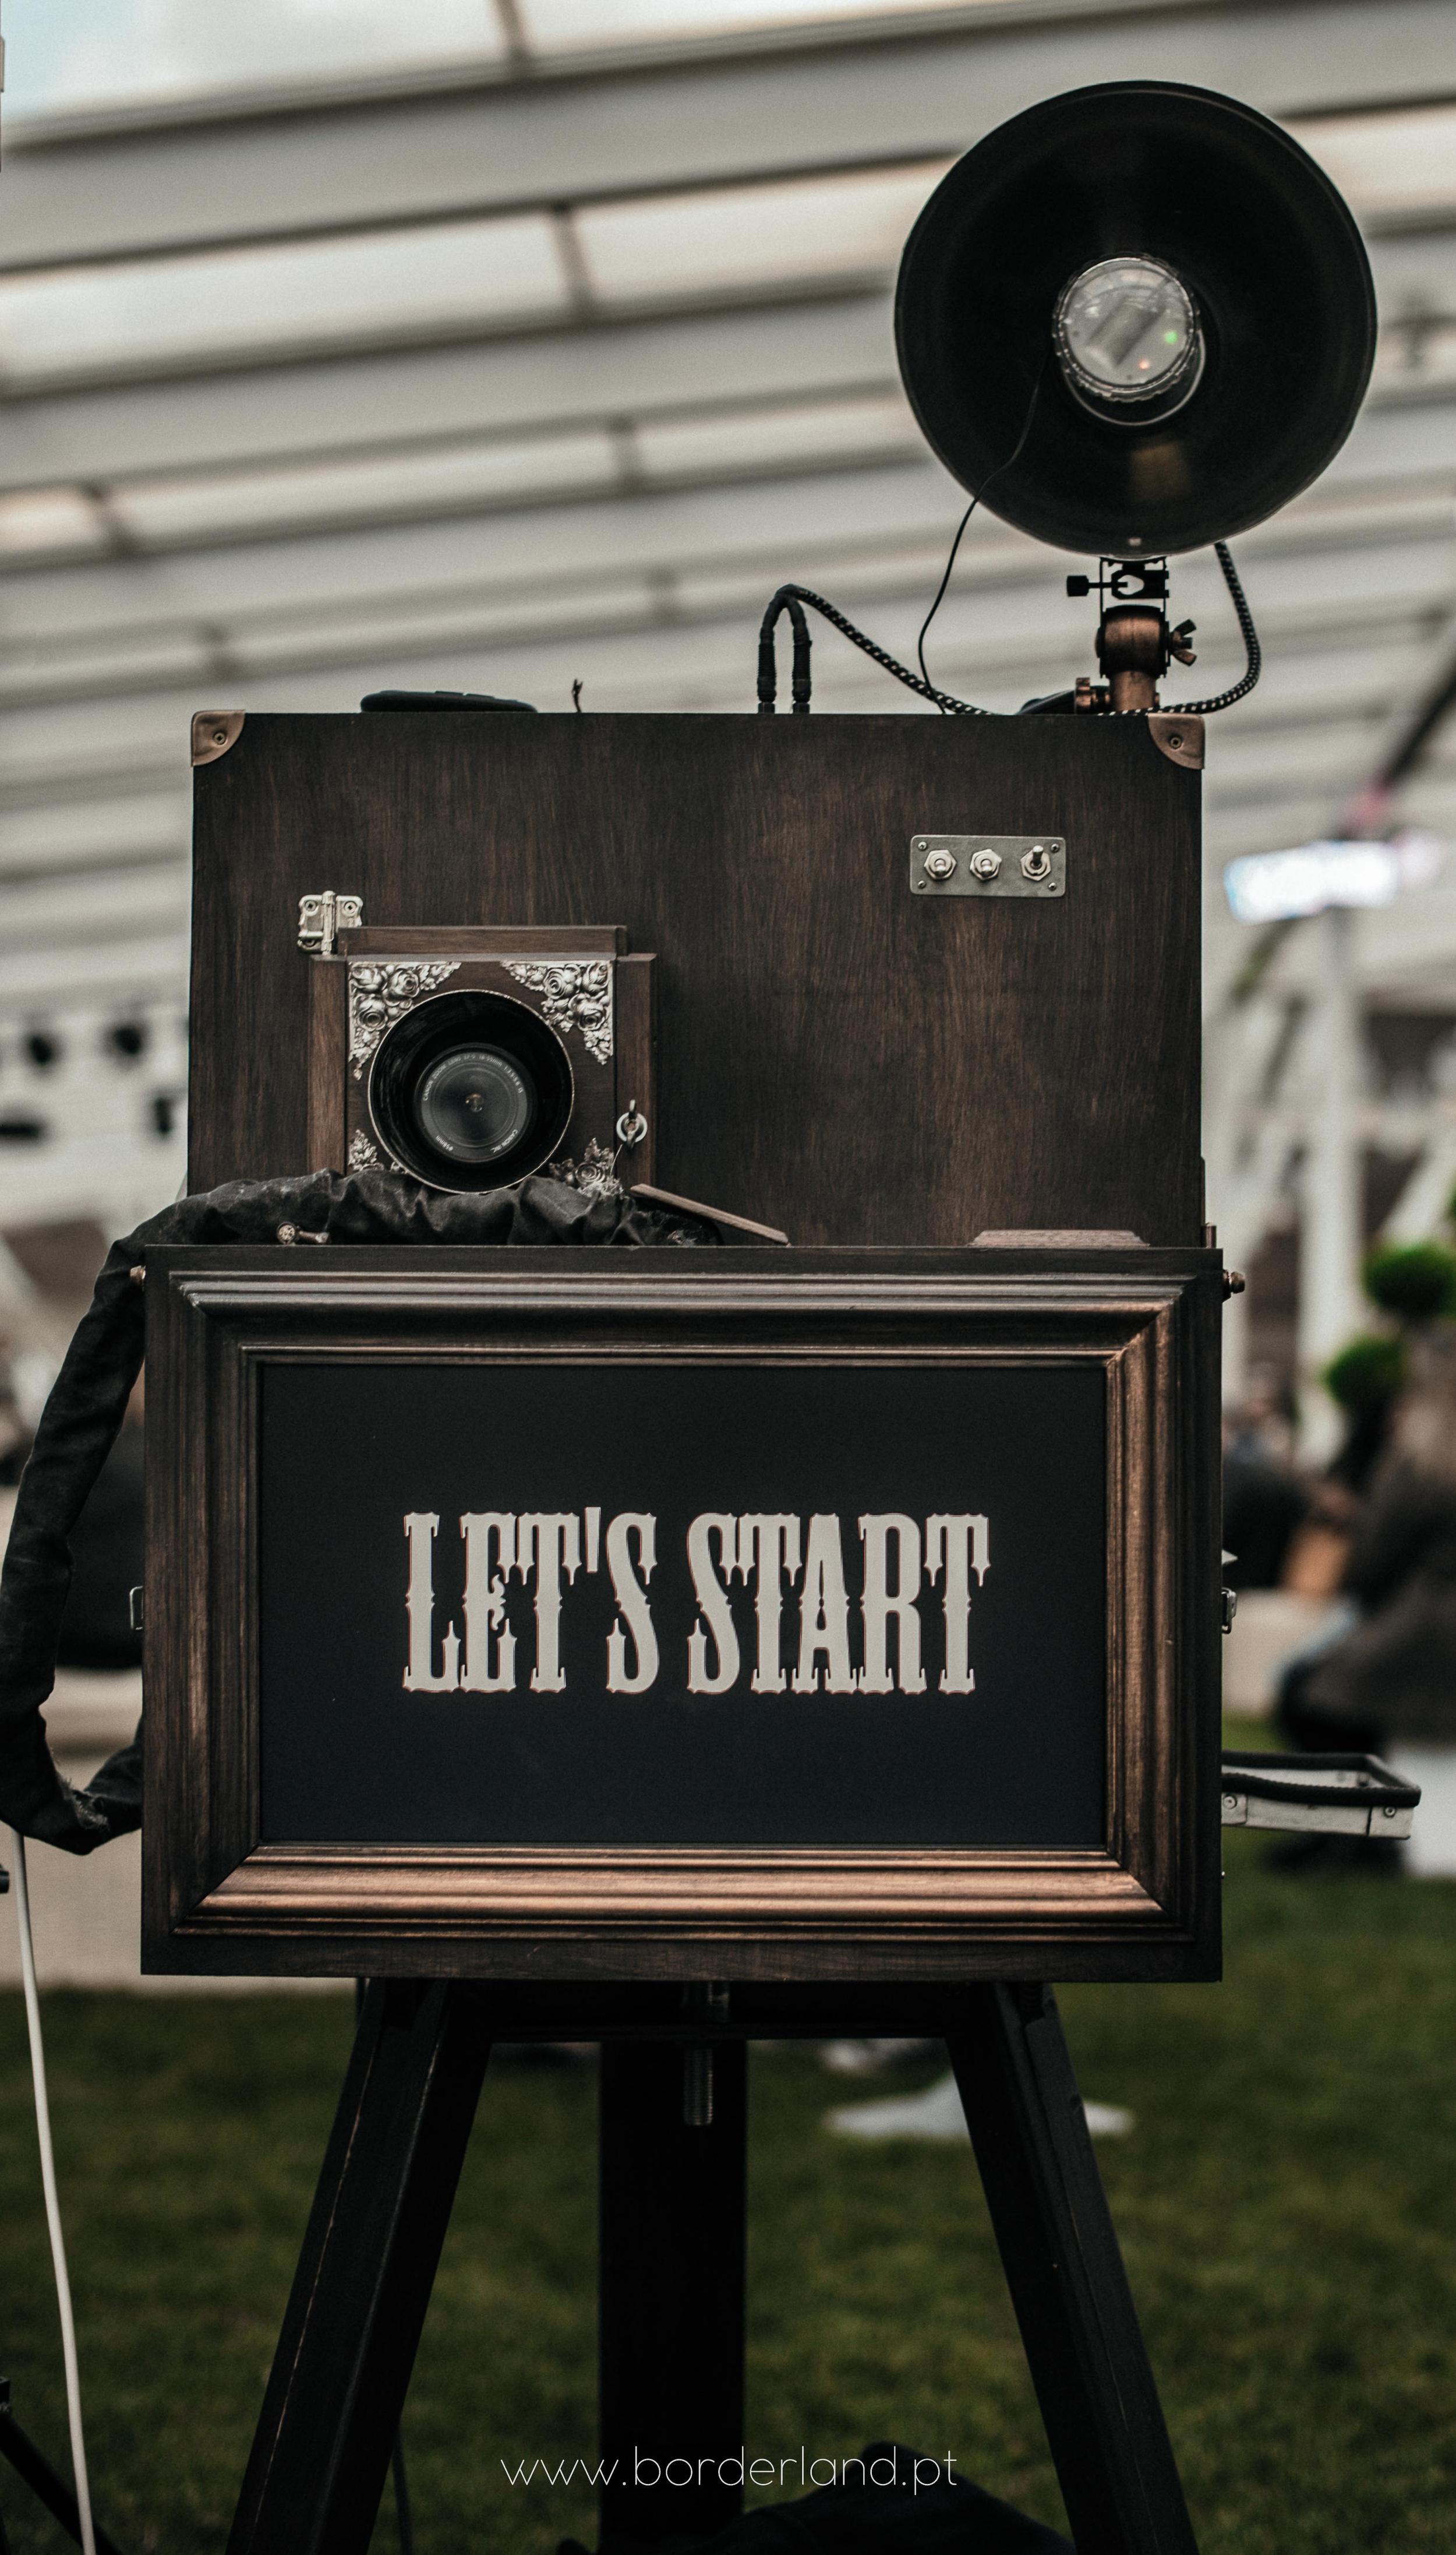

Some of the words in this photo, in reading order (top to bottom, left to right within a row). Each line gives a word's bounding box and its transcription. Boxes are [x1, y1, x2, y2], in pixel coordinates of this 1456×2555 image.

[423, 1080, 433, 1101] CANON
[501, 1129, 518, 1146] CANON
[402, 1506, 660, 1693] LET'S
[686, 1512, 991, 1695] START
